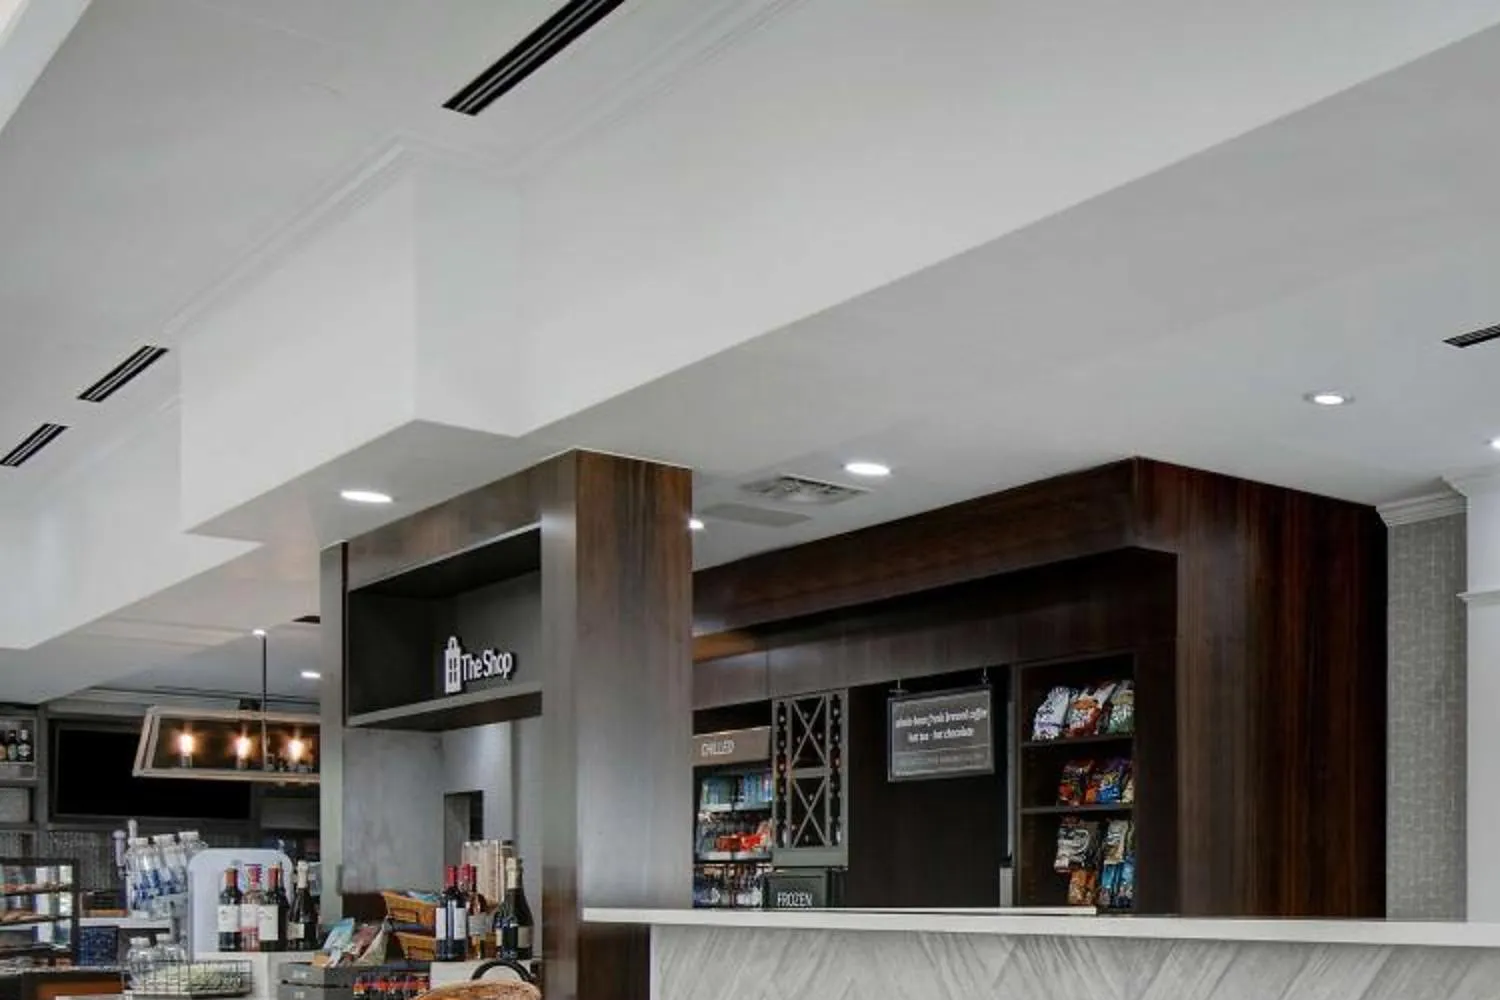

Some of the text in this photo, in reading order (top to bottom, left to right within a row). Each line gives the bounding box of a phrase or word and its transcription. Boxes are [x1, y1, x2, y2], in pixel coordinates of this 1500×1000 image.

[461, 648, 513, 681] The Shop
[701, 739, 735, 757] CHILLED
[777, 891, 813, 907] FROZEN
